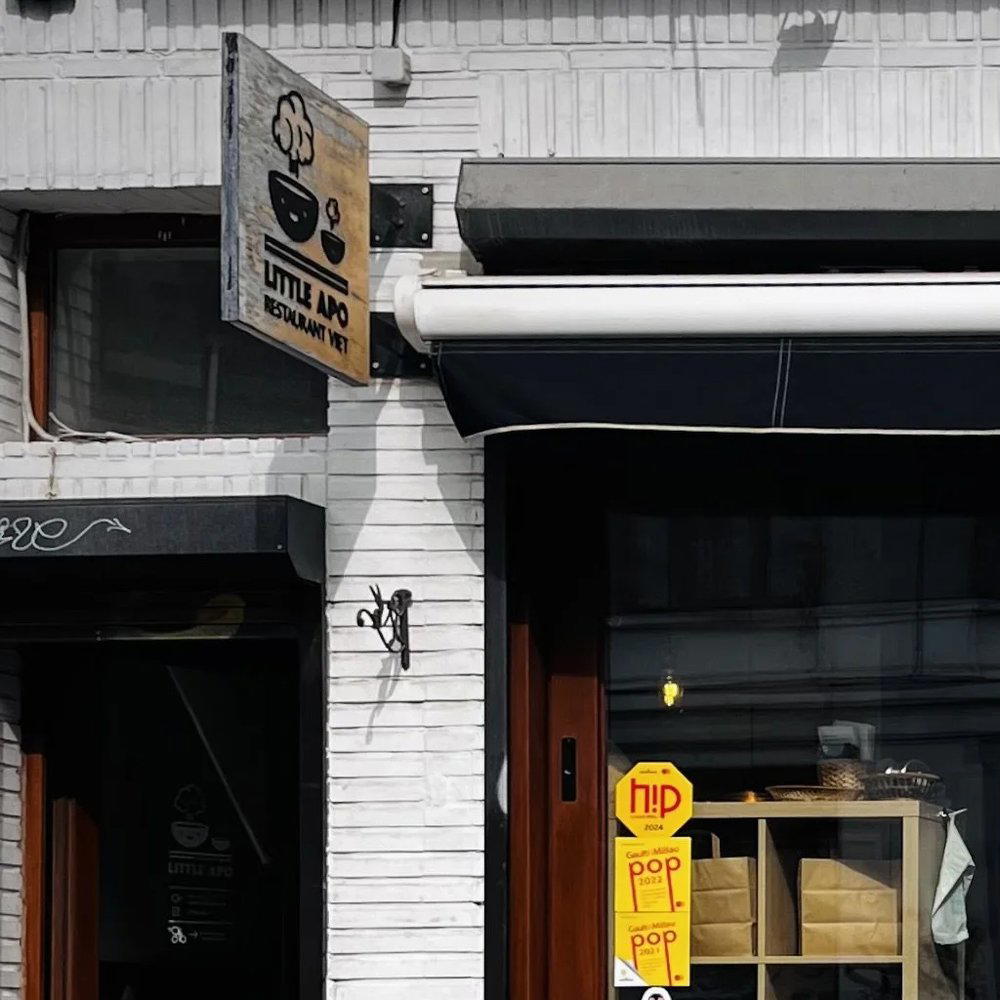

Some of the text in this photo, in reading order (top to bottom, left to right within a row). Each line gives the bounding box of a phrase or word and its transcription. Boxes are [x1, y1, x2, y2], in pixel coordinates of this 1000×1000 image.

[264, 259, 348, 328] LITTLE APO
[264, 294, 326, 342] RESTAURANT
